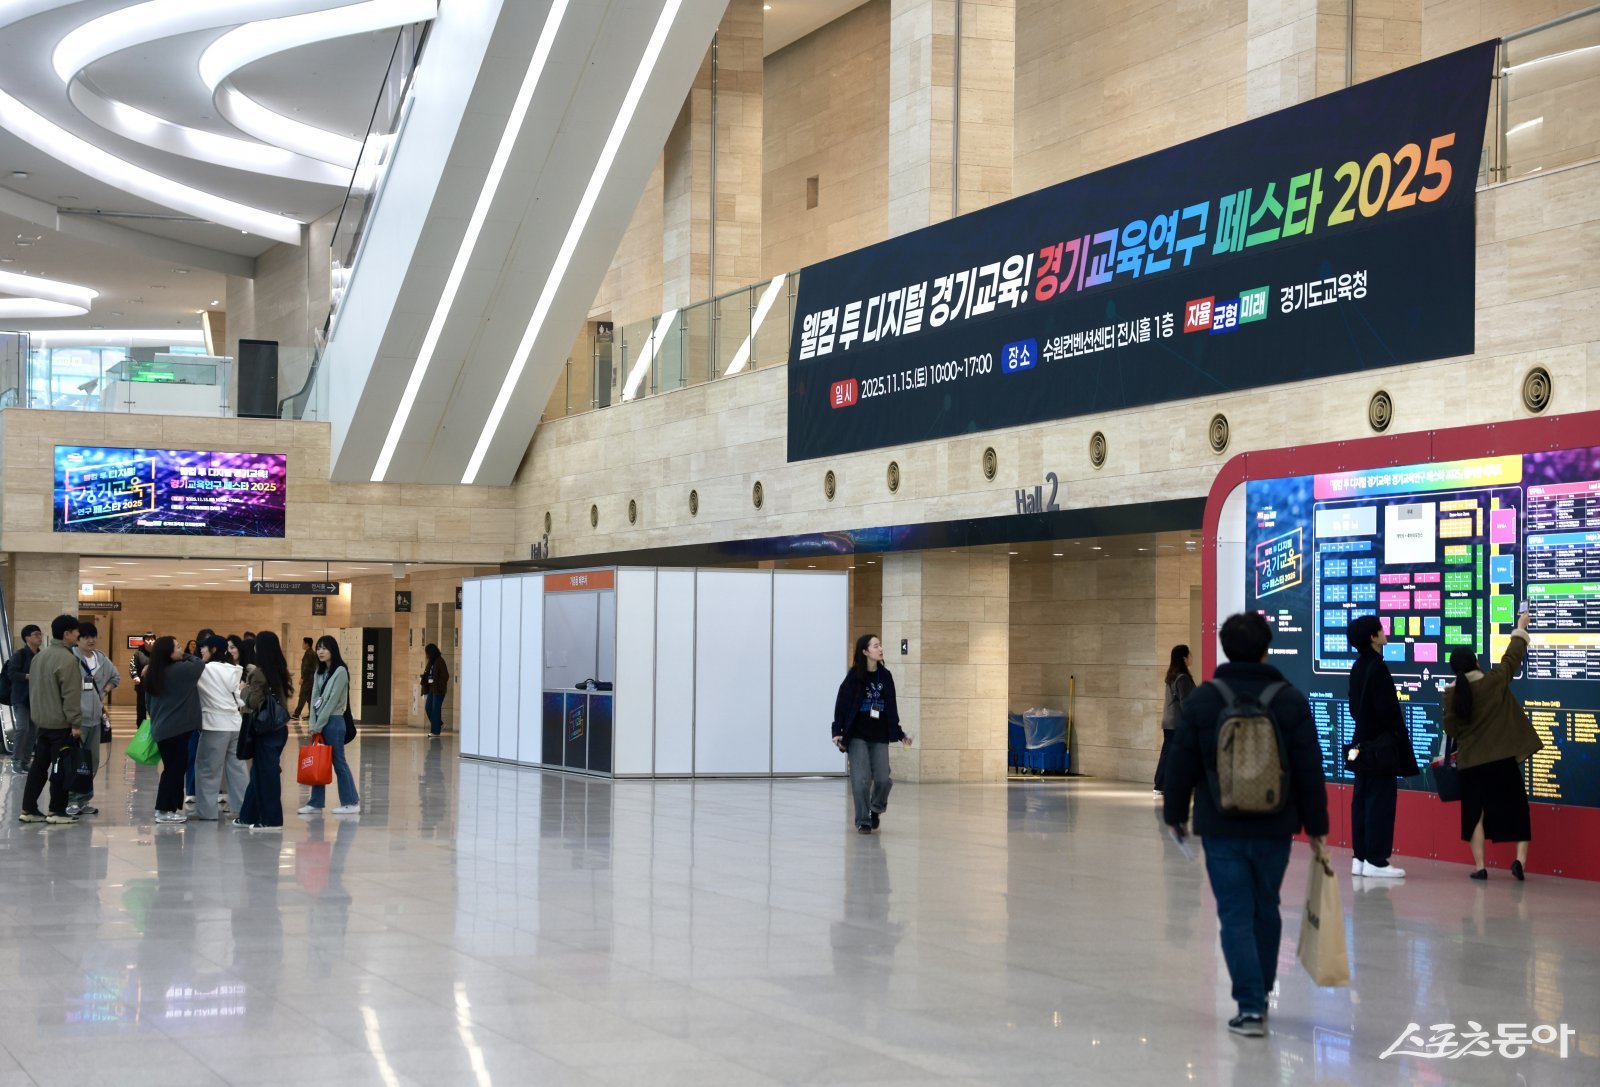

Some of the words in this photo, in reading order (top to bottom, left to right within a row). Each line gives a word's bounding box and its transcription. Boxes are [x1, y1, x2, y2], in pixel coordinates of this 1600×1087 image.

[799, 306, 839, 360] 웰컴
[839, 301, 862, 350] 투
[862, 281, 928, 343] 디지털
[929, 253, 1034, 328] 경기교육!
[1035, 201, 1210, 301] 경기교육연구
[1212, 168, 1323, 256] 페스타
[1327, 132, 1456, 227] 2025
[1187, 301, 1211, 327] 자율
[1213, 303, 1238, 330] 균형
[1241, 291, 1266, 318] 미래
[1280, 270, 1368, 314] 경기도교육청
[835, 382, 852, 405] 일시
[861, 365, 928, 399] 2025.11.15.(토)
[930, 353, 993, 384] 10:00~17:00
[1008, 345, 1031, 370] 장소
[1042, 324, 1115, 362] 수원컨벤션센터
[1117, 317, 1151, 347] 전시홀
[1154, 312, 1174, 338] 1층
[122, 500, 143, 509] 2025
[251, 482, 277, 492] 2025
[1015, 486, 1042, 514] Hall
[1046, 471, 1060, 511] 2
[543, 533, 549, 560] 3
